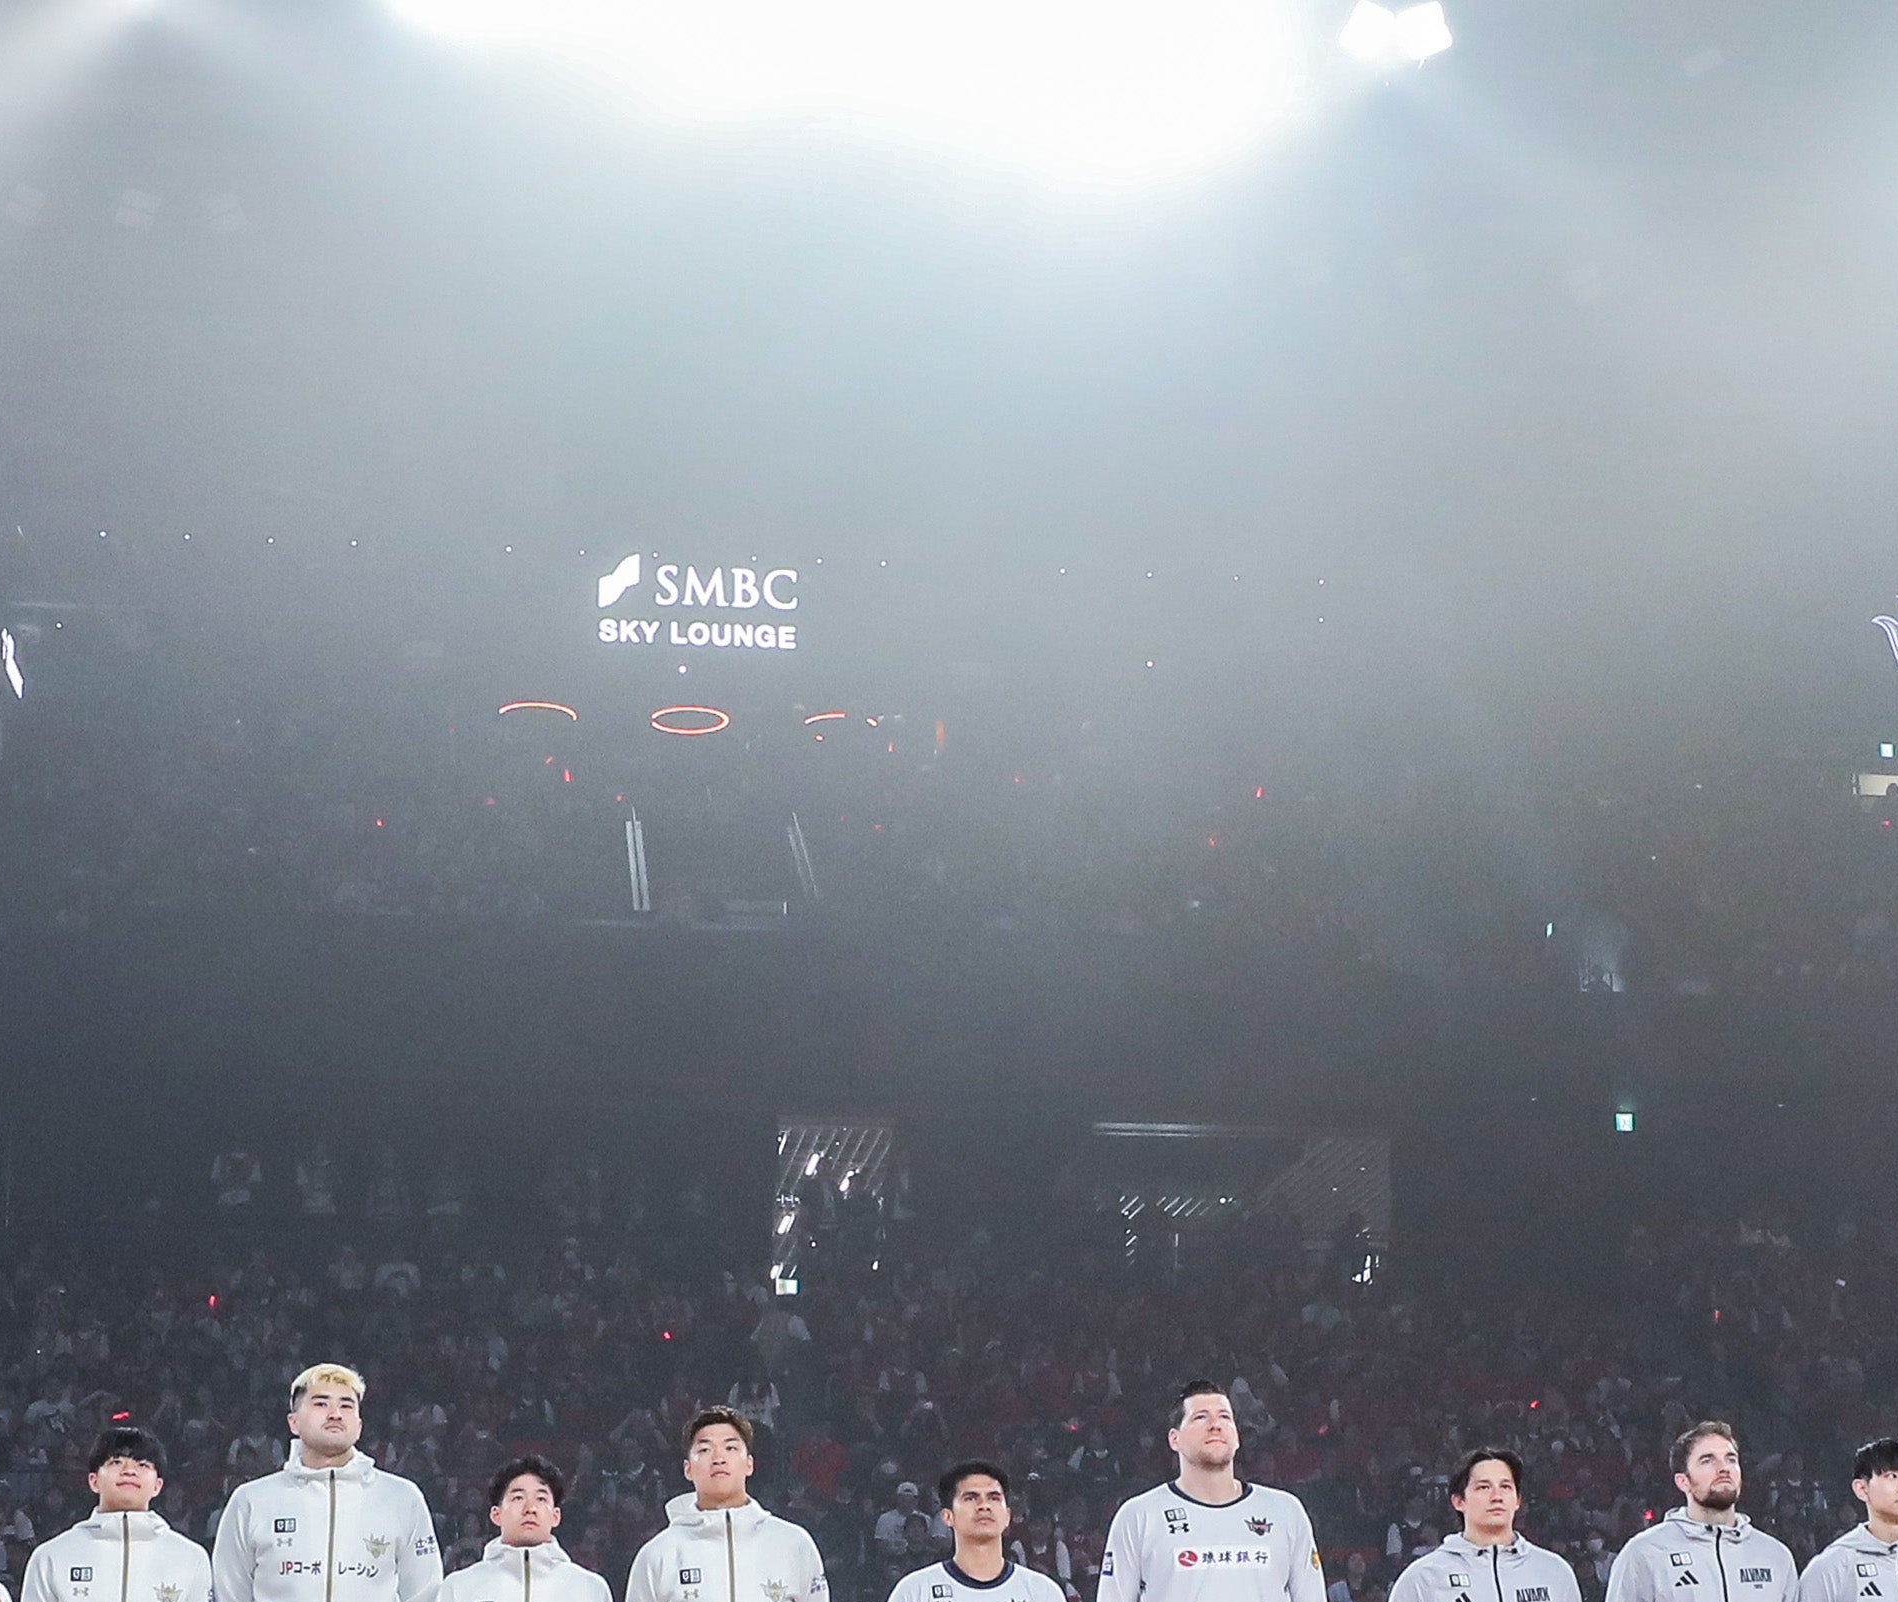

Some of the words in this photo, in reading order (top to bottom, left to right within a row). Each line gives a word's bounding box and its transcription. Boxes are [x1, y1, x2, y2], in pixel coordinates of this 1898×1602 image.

[655, 564, 798, 610] SMBC
[598, 618, 661, 644] SKY
[669, 620, 797, 650] LOUNGE
